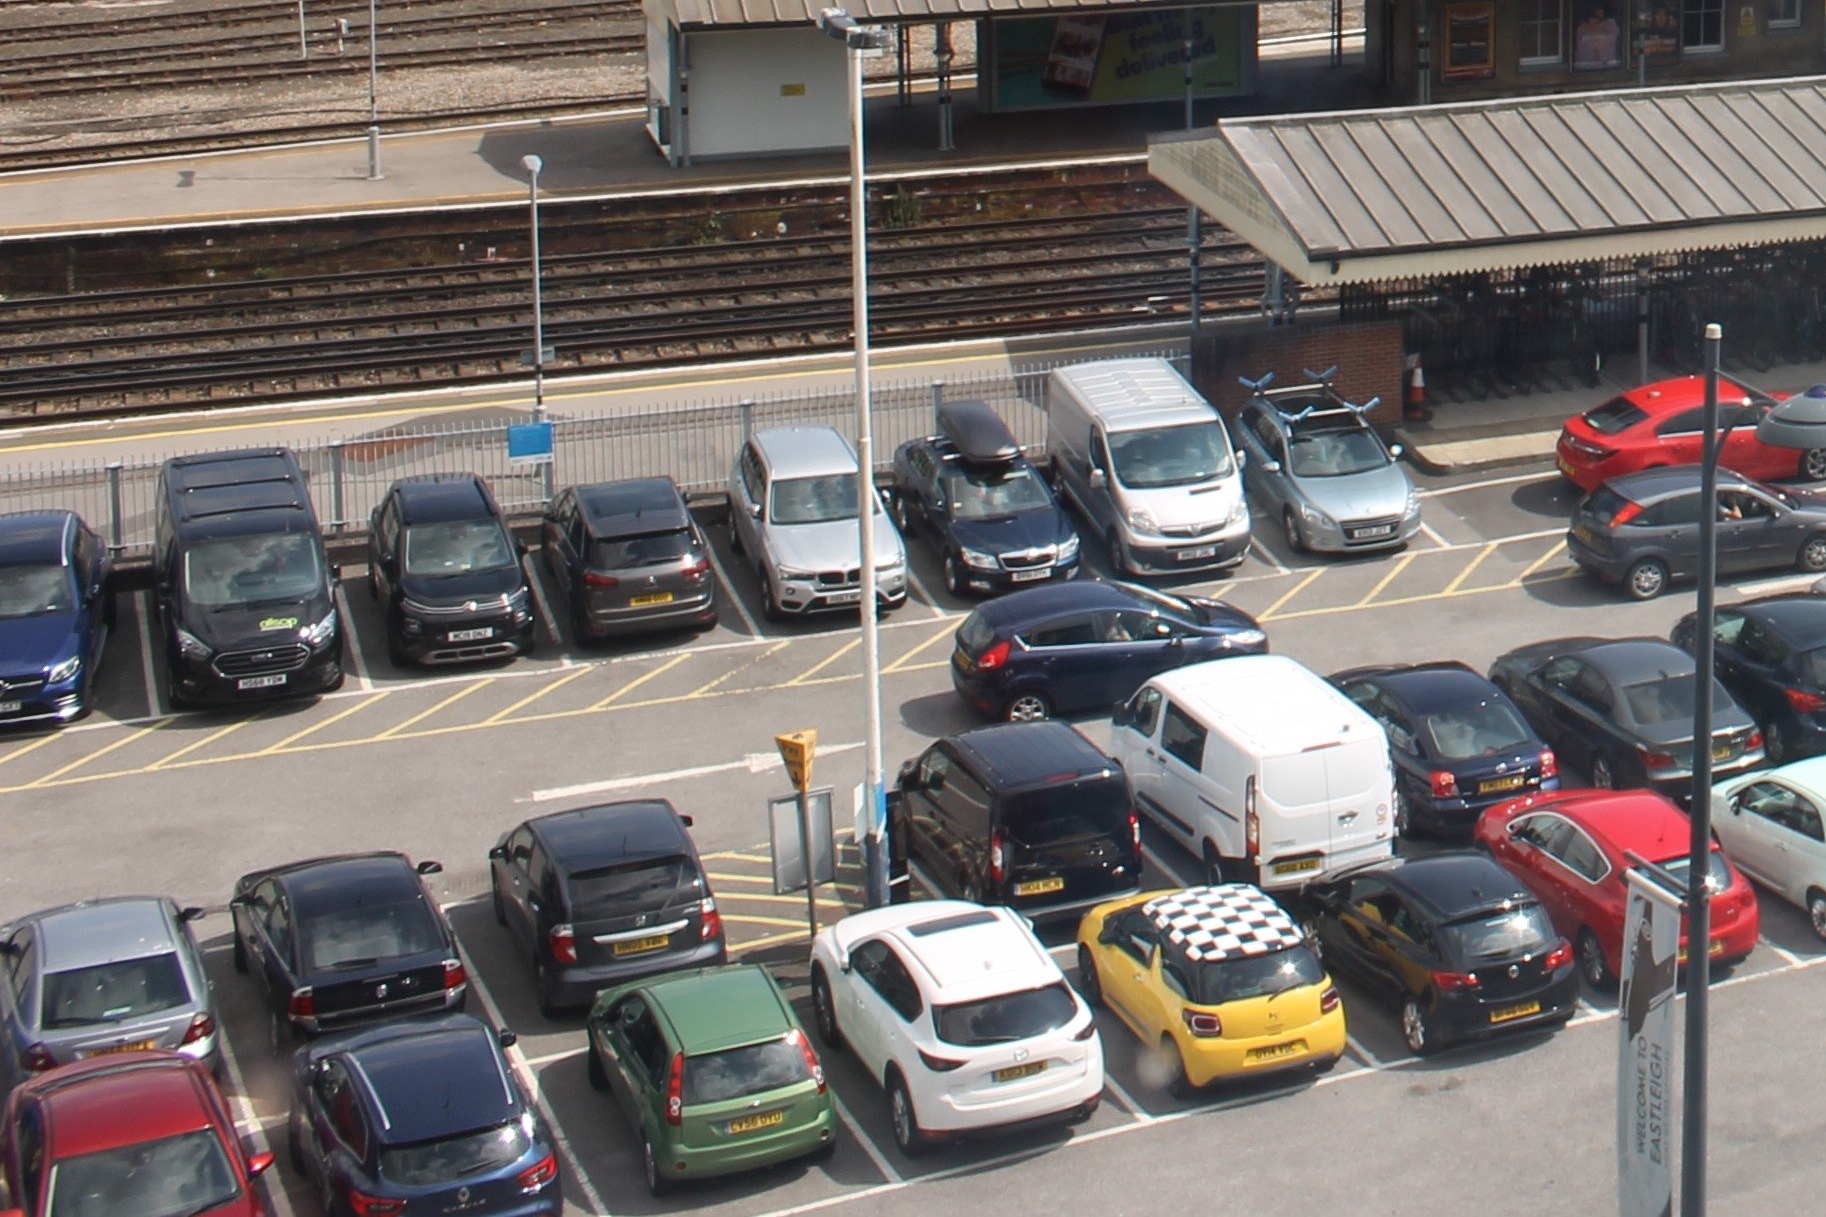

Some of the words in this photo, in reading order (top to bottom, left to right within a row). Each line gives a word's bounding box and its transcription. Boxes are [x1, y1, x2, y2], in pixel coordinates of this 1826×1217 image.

[1637, 1035, 1647, 1059] TO
[1636, 1062, 1647, 1154] WELCOME
[1649, 1042, 1663, 1165] EASTLEIGH
